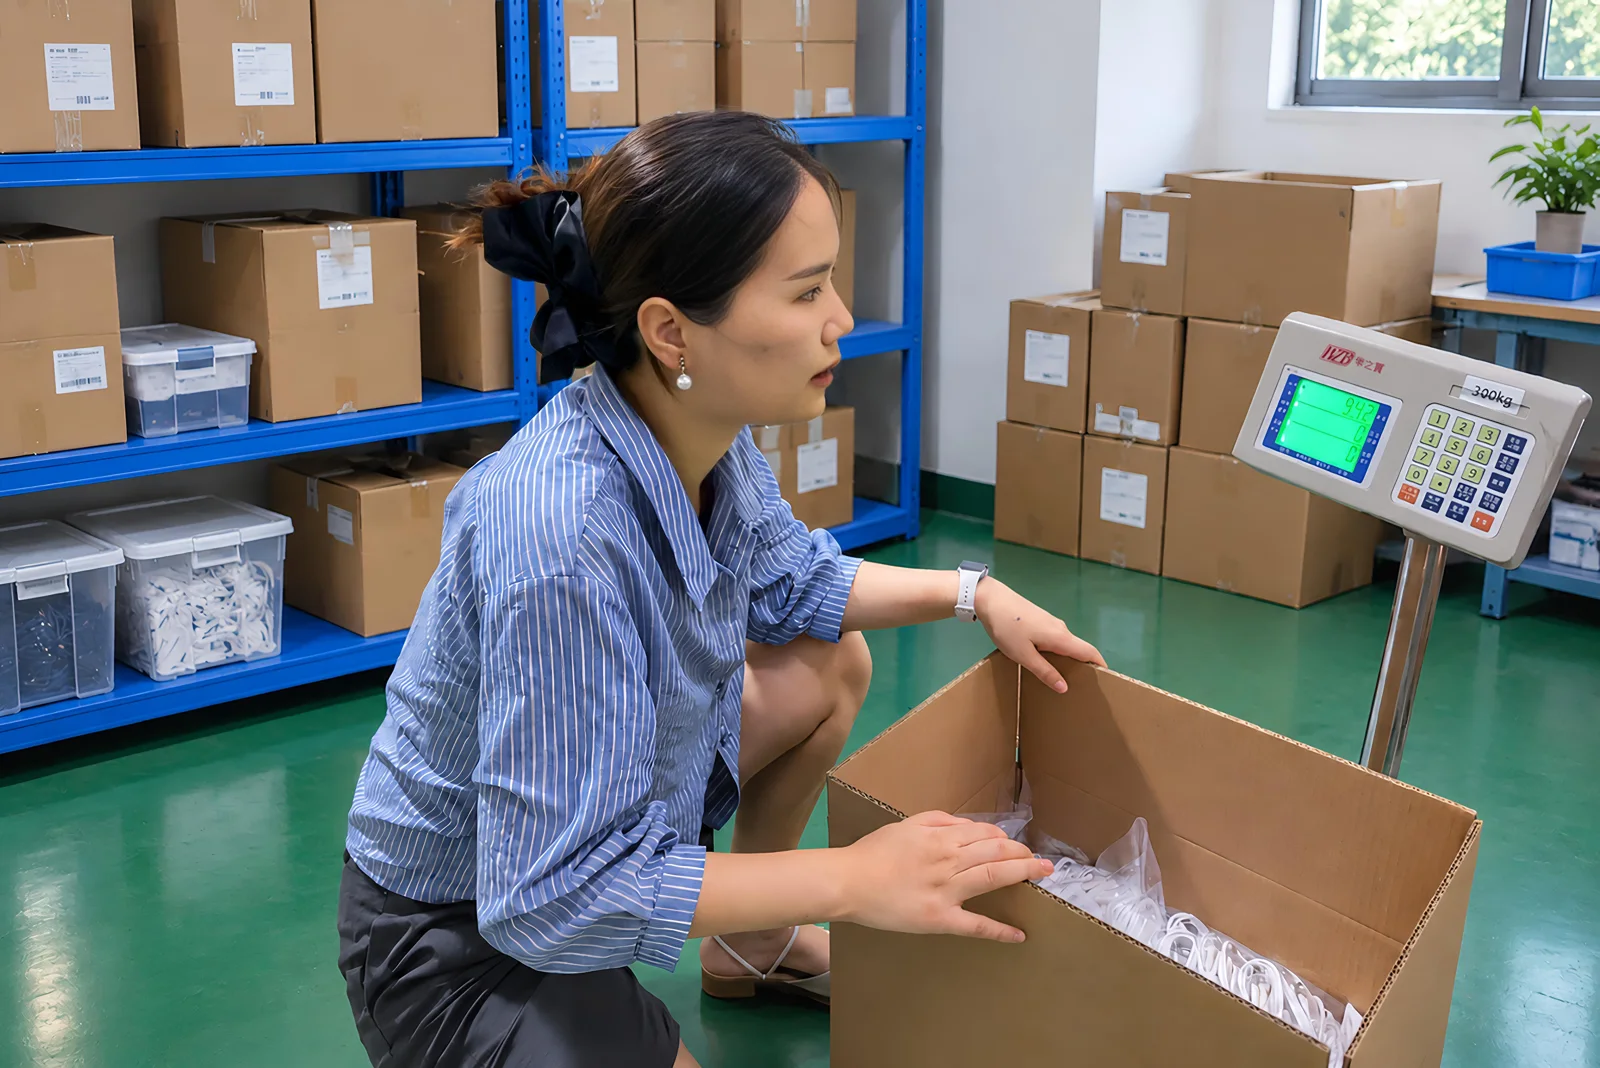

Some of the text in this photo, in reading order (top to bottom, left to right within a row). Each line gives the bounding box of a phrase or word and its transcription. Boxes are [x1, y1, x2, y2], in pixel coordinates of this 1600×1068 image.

[1471, 385, 1513, 409] 300kg
[1435, 414, 1494, 441] 1 2 3
[1419, 451, 1428, 461] 7
[1468, 468, 1478, 479] 9
[1476, 450, 1485, 461] 6
